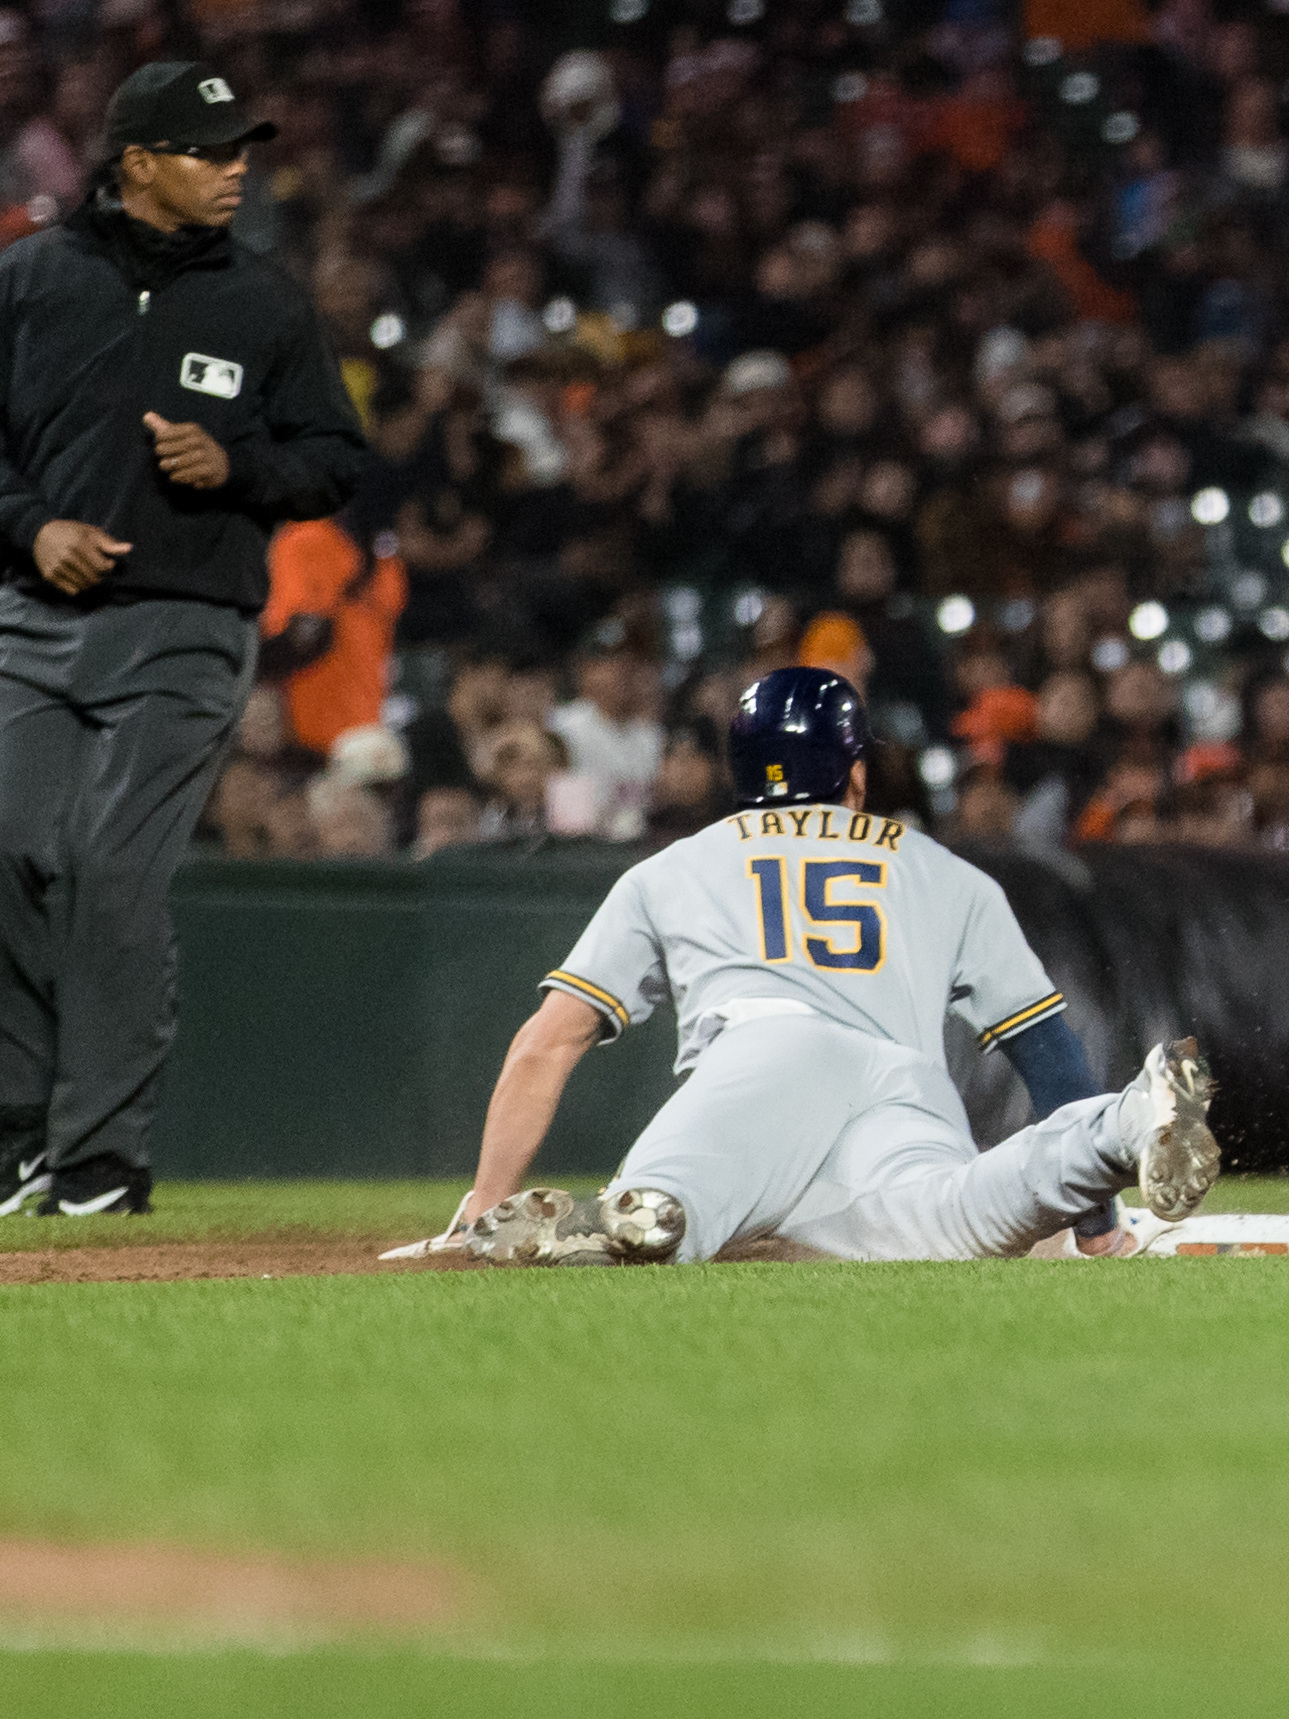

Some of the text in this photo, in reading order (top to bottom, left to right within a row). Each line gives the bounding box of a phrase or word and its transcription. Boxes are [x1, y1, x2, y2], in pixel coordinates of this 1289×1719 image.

[766, 764, 783, 782] 15
[728, 810, 906, 853] TAYLOR
[746, 856, 887, 975] 15
